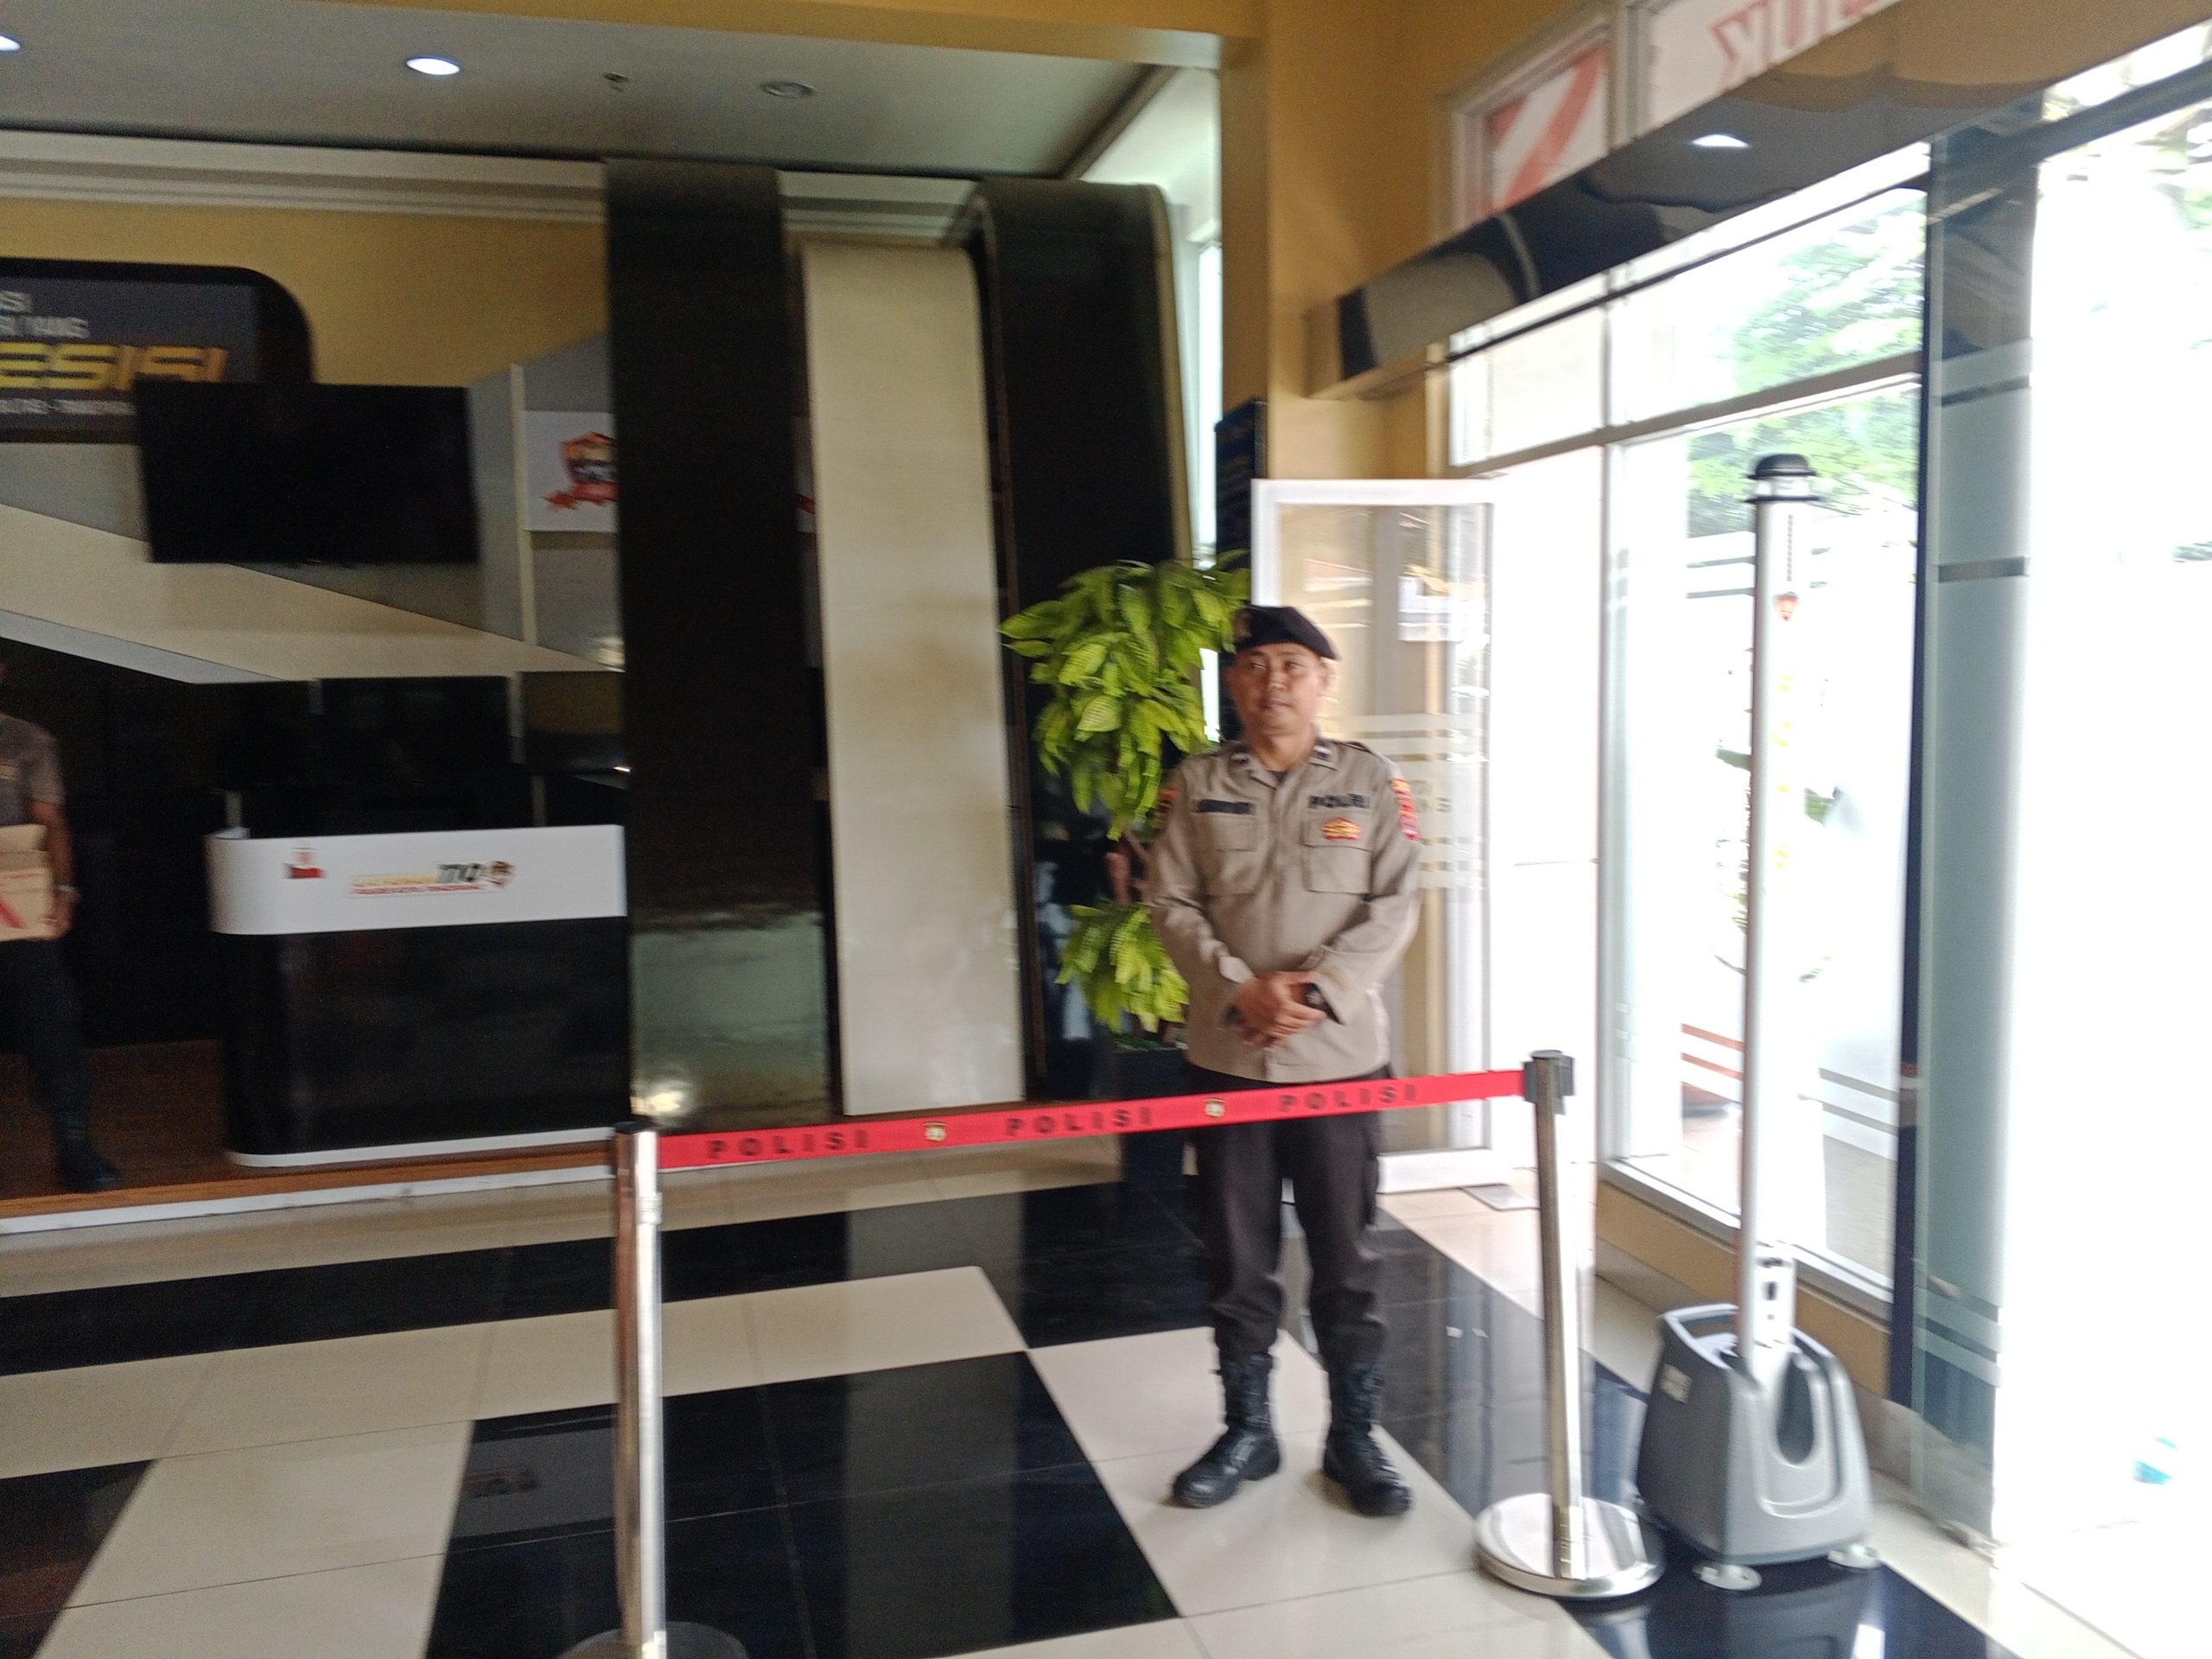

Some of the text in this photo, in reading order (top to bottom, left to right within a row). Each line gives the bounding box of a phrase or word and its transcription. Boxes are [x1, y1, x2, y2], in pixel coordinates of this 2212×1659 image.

[705, 1083, 1418, 1160] POLISI POLISI POLISI
